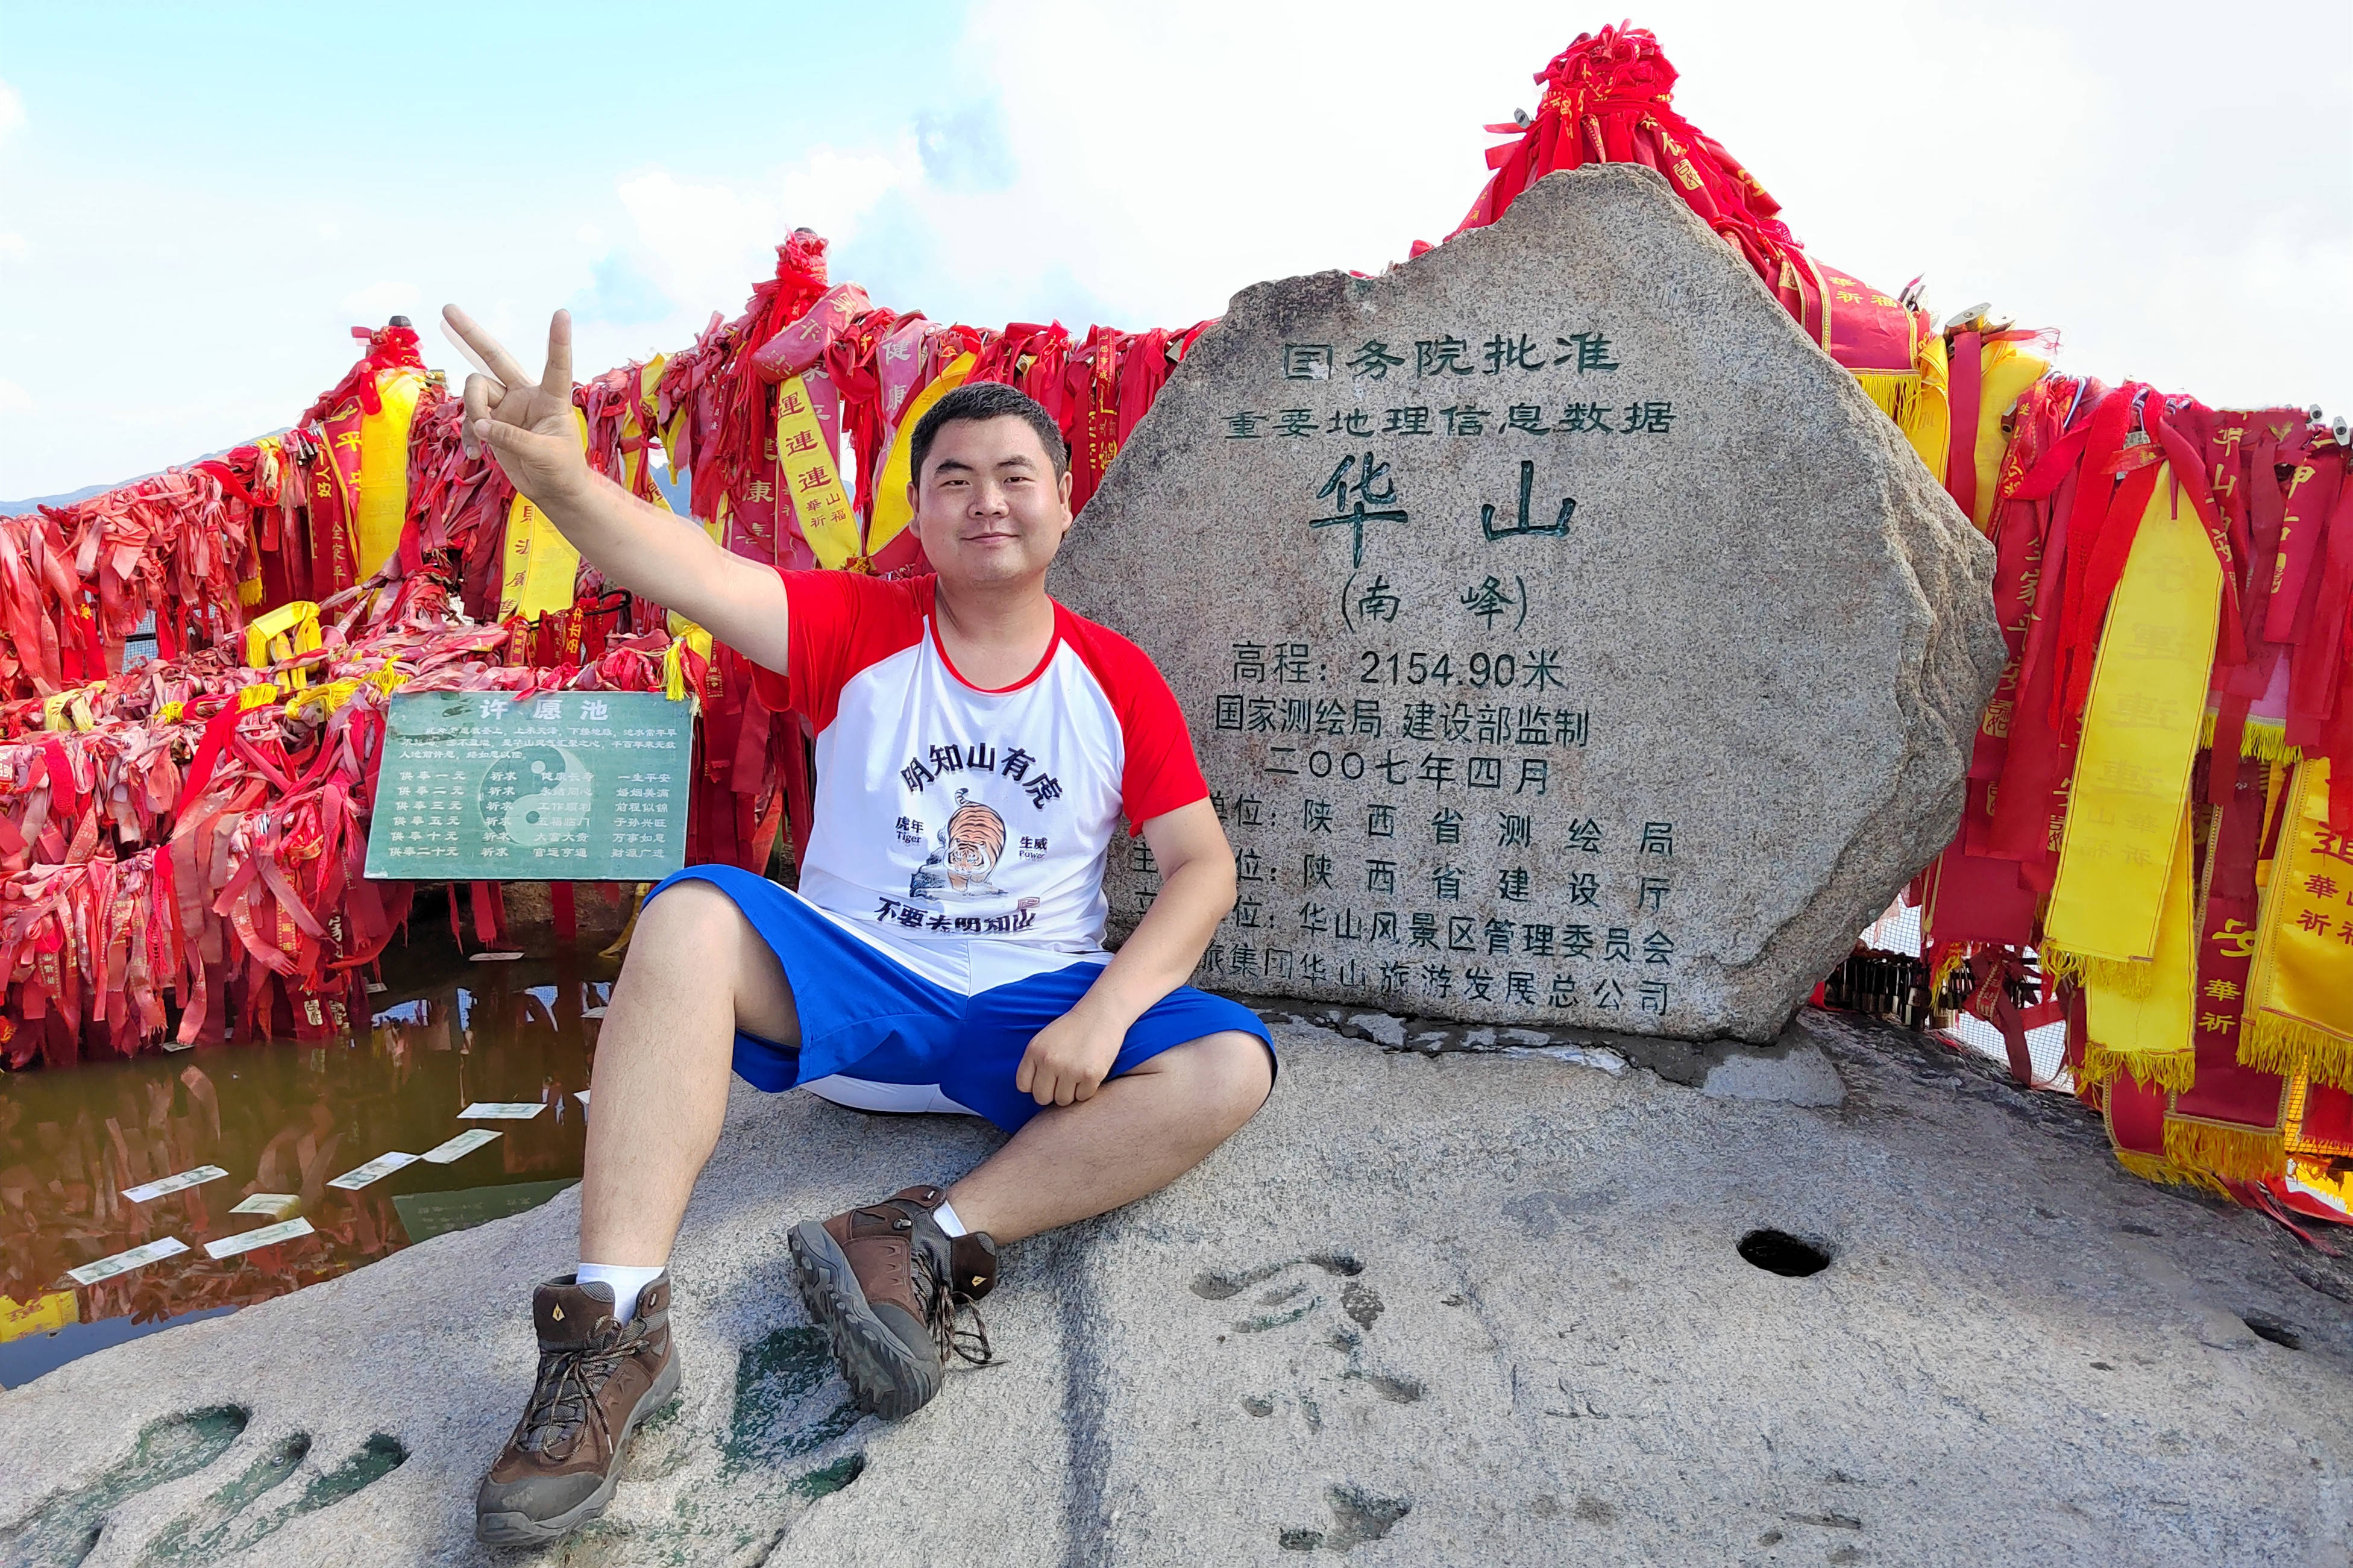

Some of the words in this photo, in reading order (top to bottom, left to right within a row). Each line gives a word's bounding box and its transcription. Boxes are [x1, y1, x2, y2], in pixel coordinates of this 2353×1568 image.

[1283, 331, 1621, 381] 国务院批准
[1223, 400, 1678, 440] 重要地理信息数据
[1308, 451, 1577, 569] 华山
[480, 698, 609, 721] 许愿池
[1215, 694, 1381, 739] 国家测绘局
[1403, 701, 1589, 747] 建设部监制
[900, 742, 1063, 809] 明知山有虎
[896, 816, 923, 834] 虎年
[896, 832, 922, 844] Tiger
[874, 897, 1037, 933] 不要去明知山
